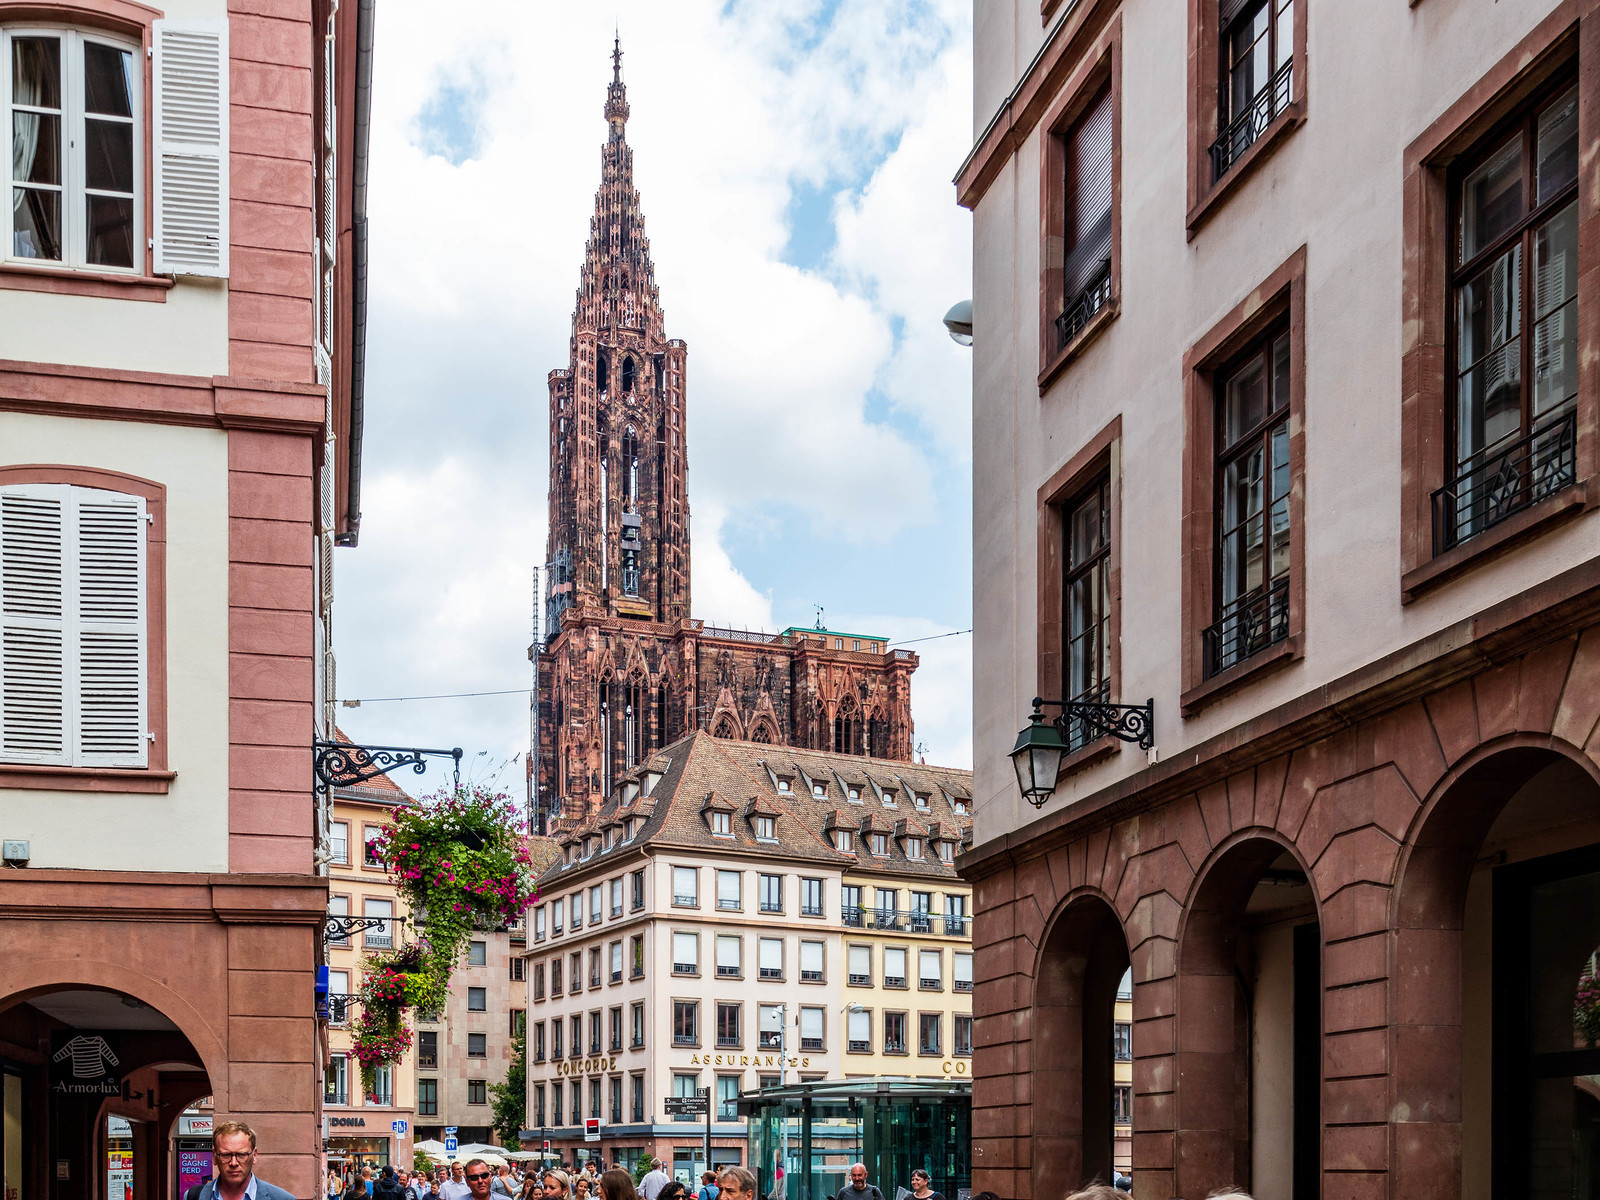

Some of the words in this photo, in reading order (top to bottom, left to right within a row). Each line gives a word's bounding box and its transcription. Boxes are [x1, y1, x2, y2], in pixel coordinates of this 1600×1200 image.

[556, 1056, 617, 1076] CONCORDE
[691, 1053, 811, 1068] ASSURANCES
[942, 1061, 973, 1075] CO
